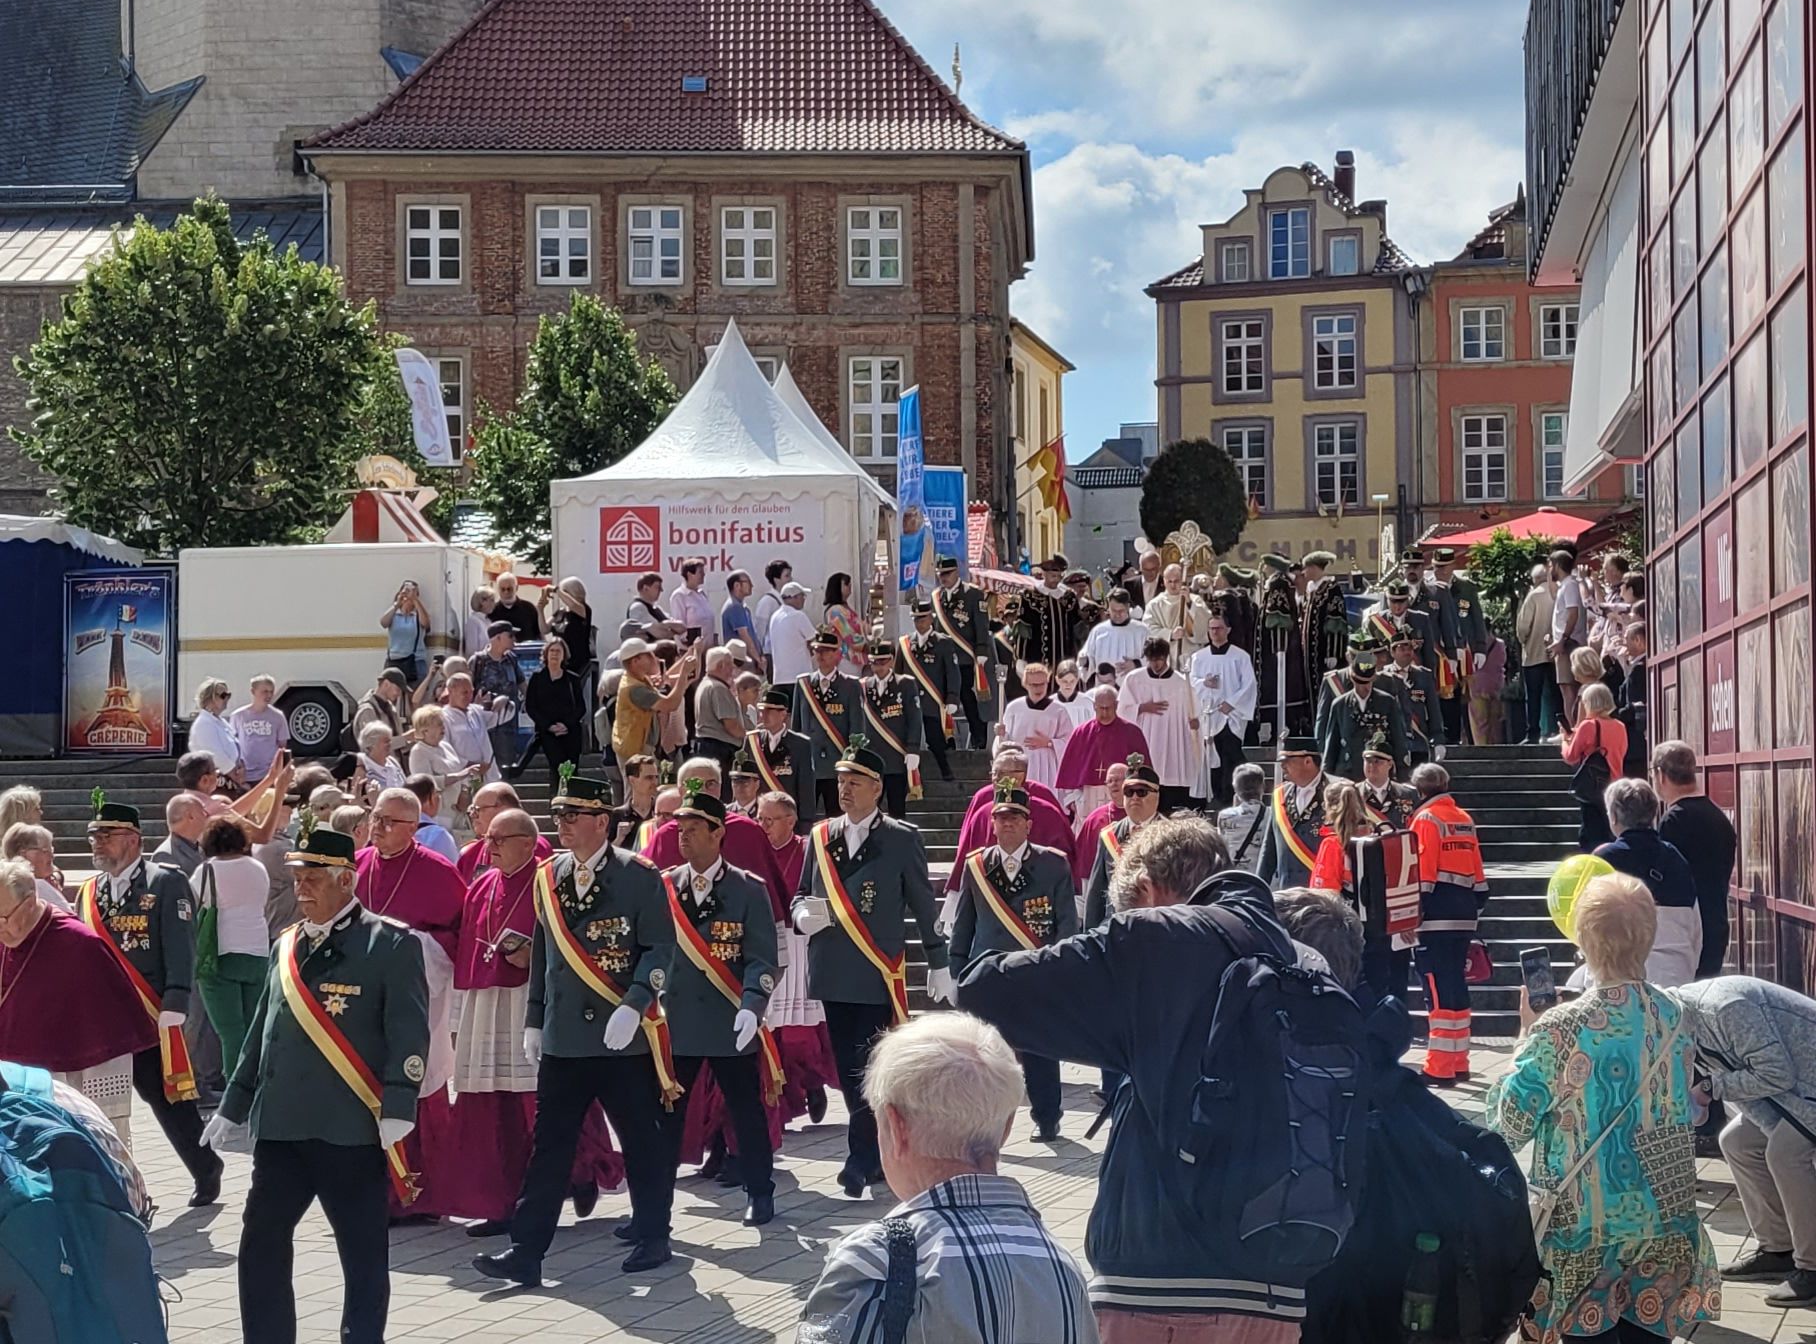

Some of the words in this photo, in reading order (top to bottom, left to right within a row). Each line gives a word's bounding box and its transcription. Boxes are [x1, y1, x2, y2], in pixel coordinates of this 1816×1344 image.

[668, 504, 713, 515] Hilfswerk
[715, 504, 728, 515] für
[731, 504, 749, 514] den
[752, 503, 790, 514] Glauben
[668, 520, 805, 545] bonifatius
[1717, 532, 1731, 604] Wir
[1711, 662, 1734, 733] sehen
[89, 725, 145, 744] CRÊPERIE
